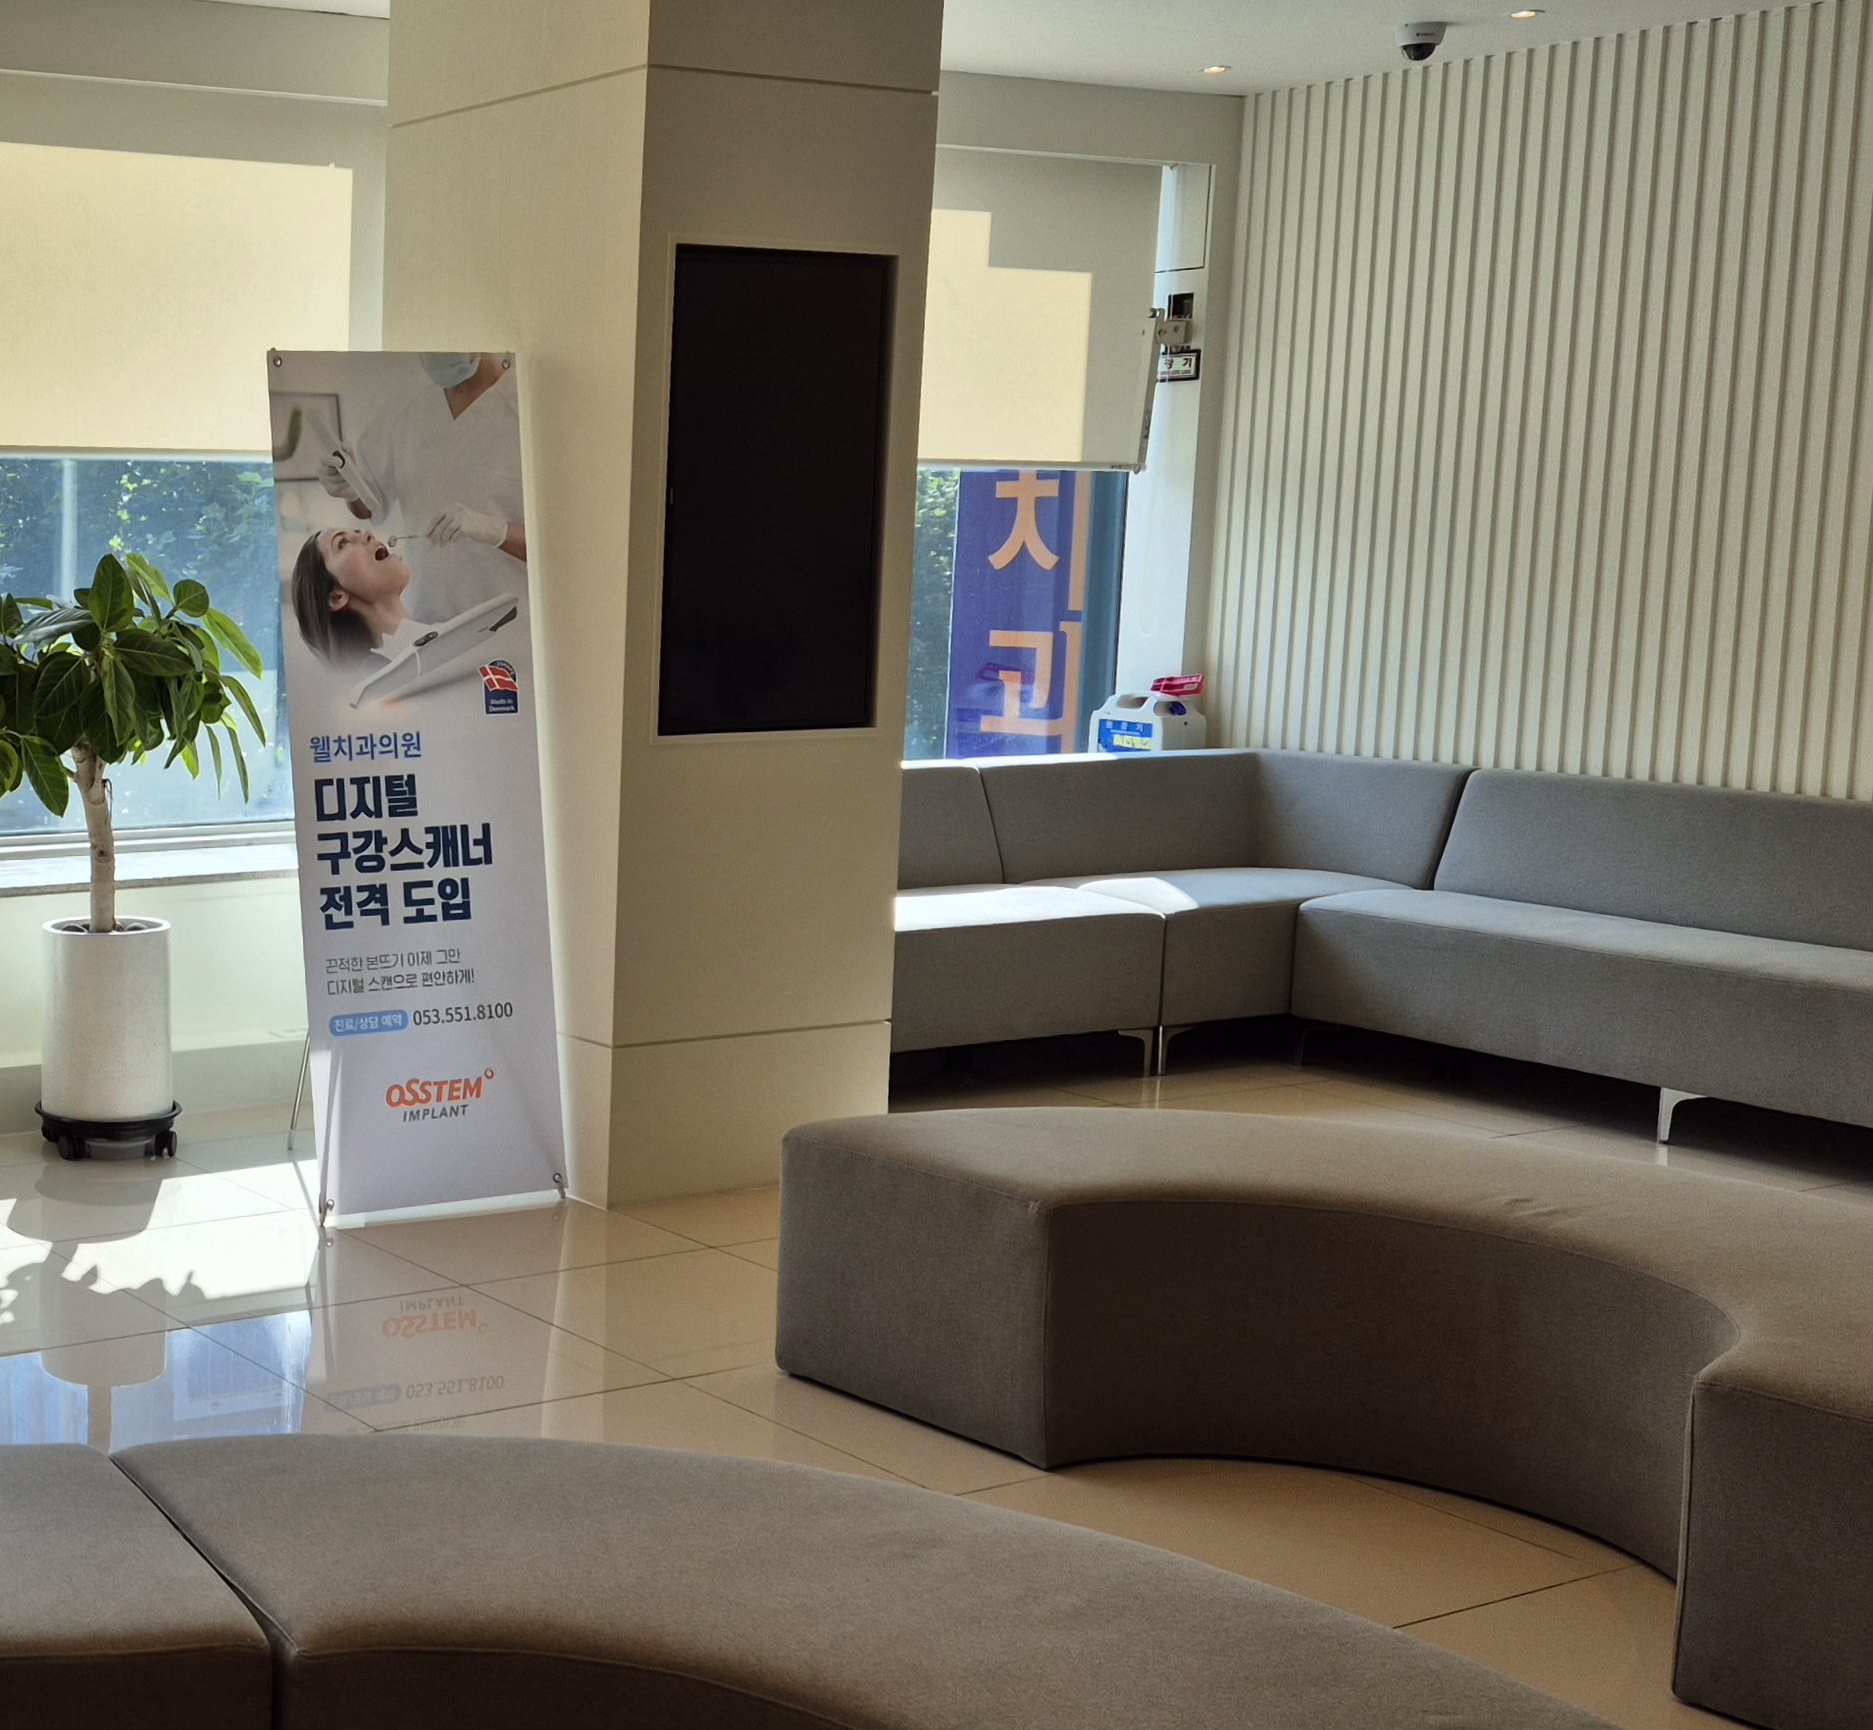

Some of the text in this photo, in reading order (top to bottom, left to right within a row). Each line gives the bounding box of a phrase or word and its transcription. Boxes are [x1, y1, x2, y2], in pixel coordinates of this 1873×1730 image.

[310, 731, 422, 763] 웰치과의원
[314, 773, 419, 822] 디지털
[317, 823, 493, 875] 구강스캐너
[320, 877, 472, 931] 전격 도입
[366, 952, 404, 971] 본뜨기
[407, 950, 433, 967] 이제
[435, 948, 461, 965] 그만
[327, 968, 475, 996] 디지털 스캔으로 편안하게!
[334, 1001, 513, 1033] 진료/상담 예약 053.551.8100
[386, 1076, 483, 1108] OSSTEM
[402, 1104, 469, 1122] IMPLANT
